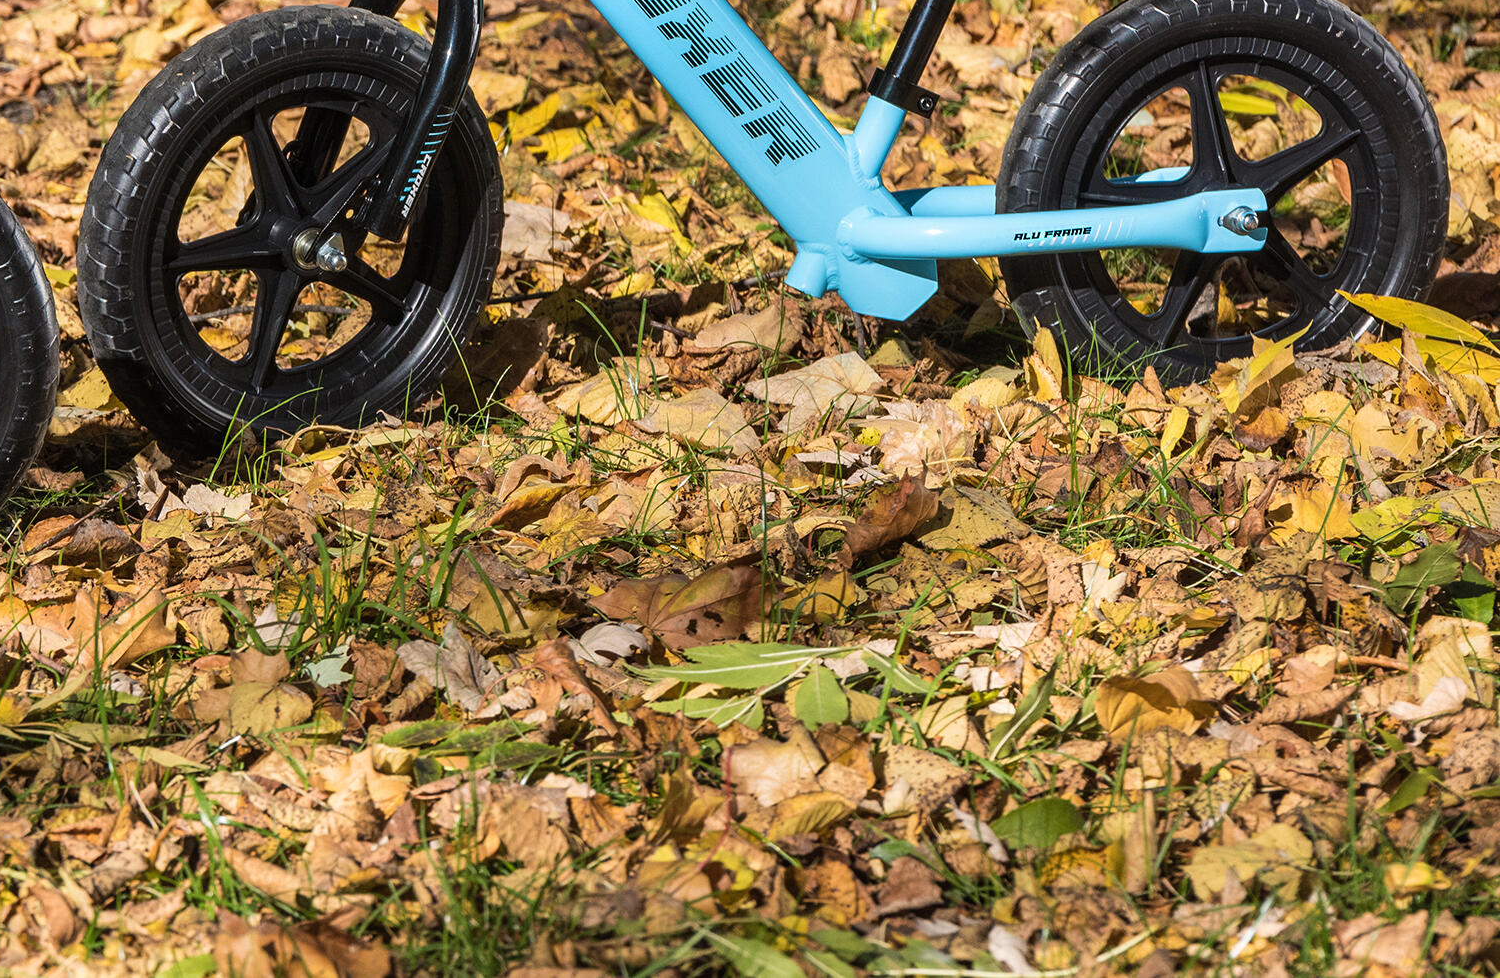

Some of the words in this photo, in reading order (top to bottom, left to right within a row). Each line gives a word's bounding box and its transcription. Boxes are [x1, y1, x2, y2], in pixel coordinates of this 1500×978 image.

[401, 153, 432, 218] CROXER
[1013, 231, 1041, 241] ALU
[1044, 226, 1092, 238] FRAME
